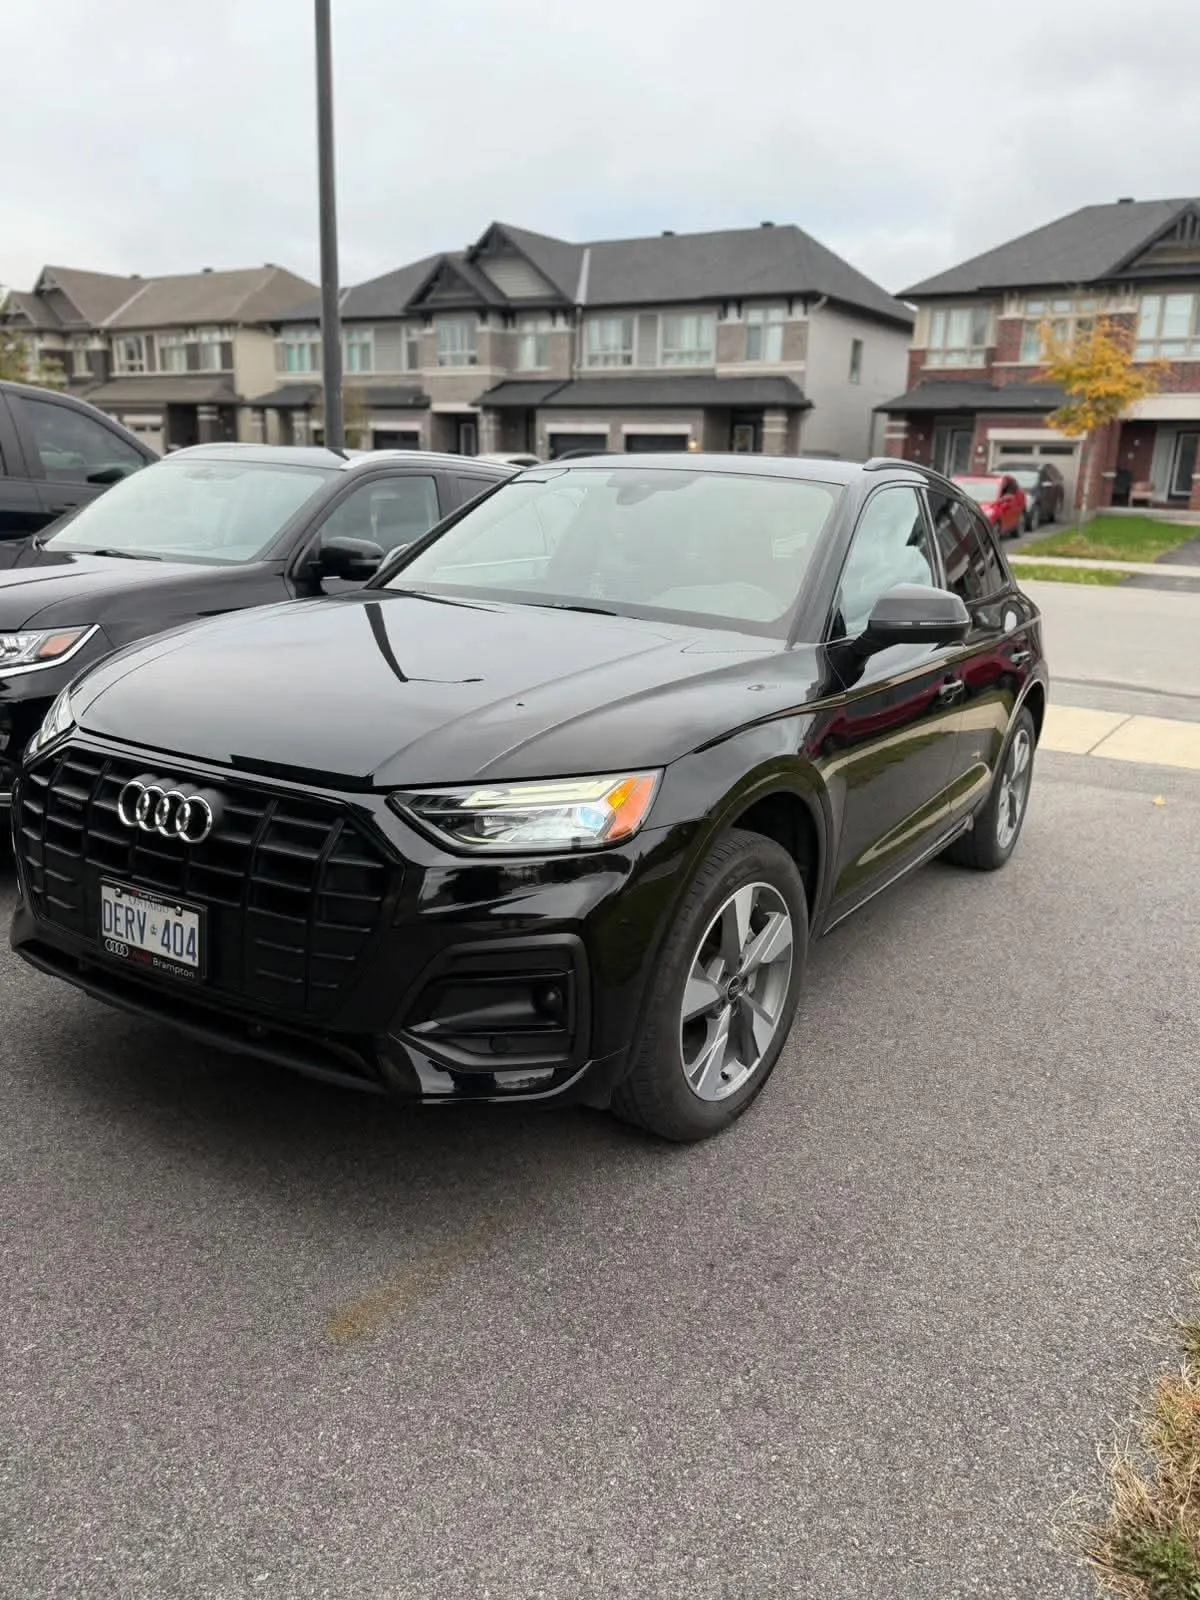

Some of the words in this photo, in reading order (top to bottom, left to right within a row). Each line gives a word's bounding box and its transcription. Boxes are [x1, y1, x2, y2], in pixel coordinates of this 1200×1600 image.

[103, 898, 146, 945] DERV
[161, 919, 197, 962] 404
[152, 957, 194, 978] Brampton
